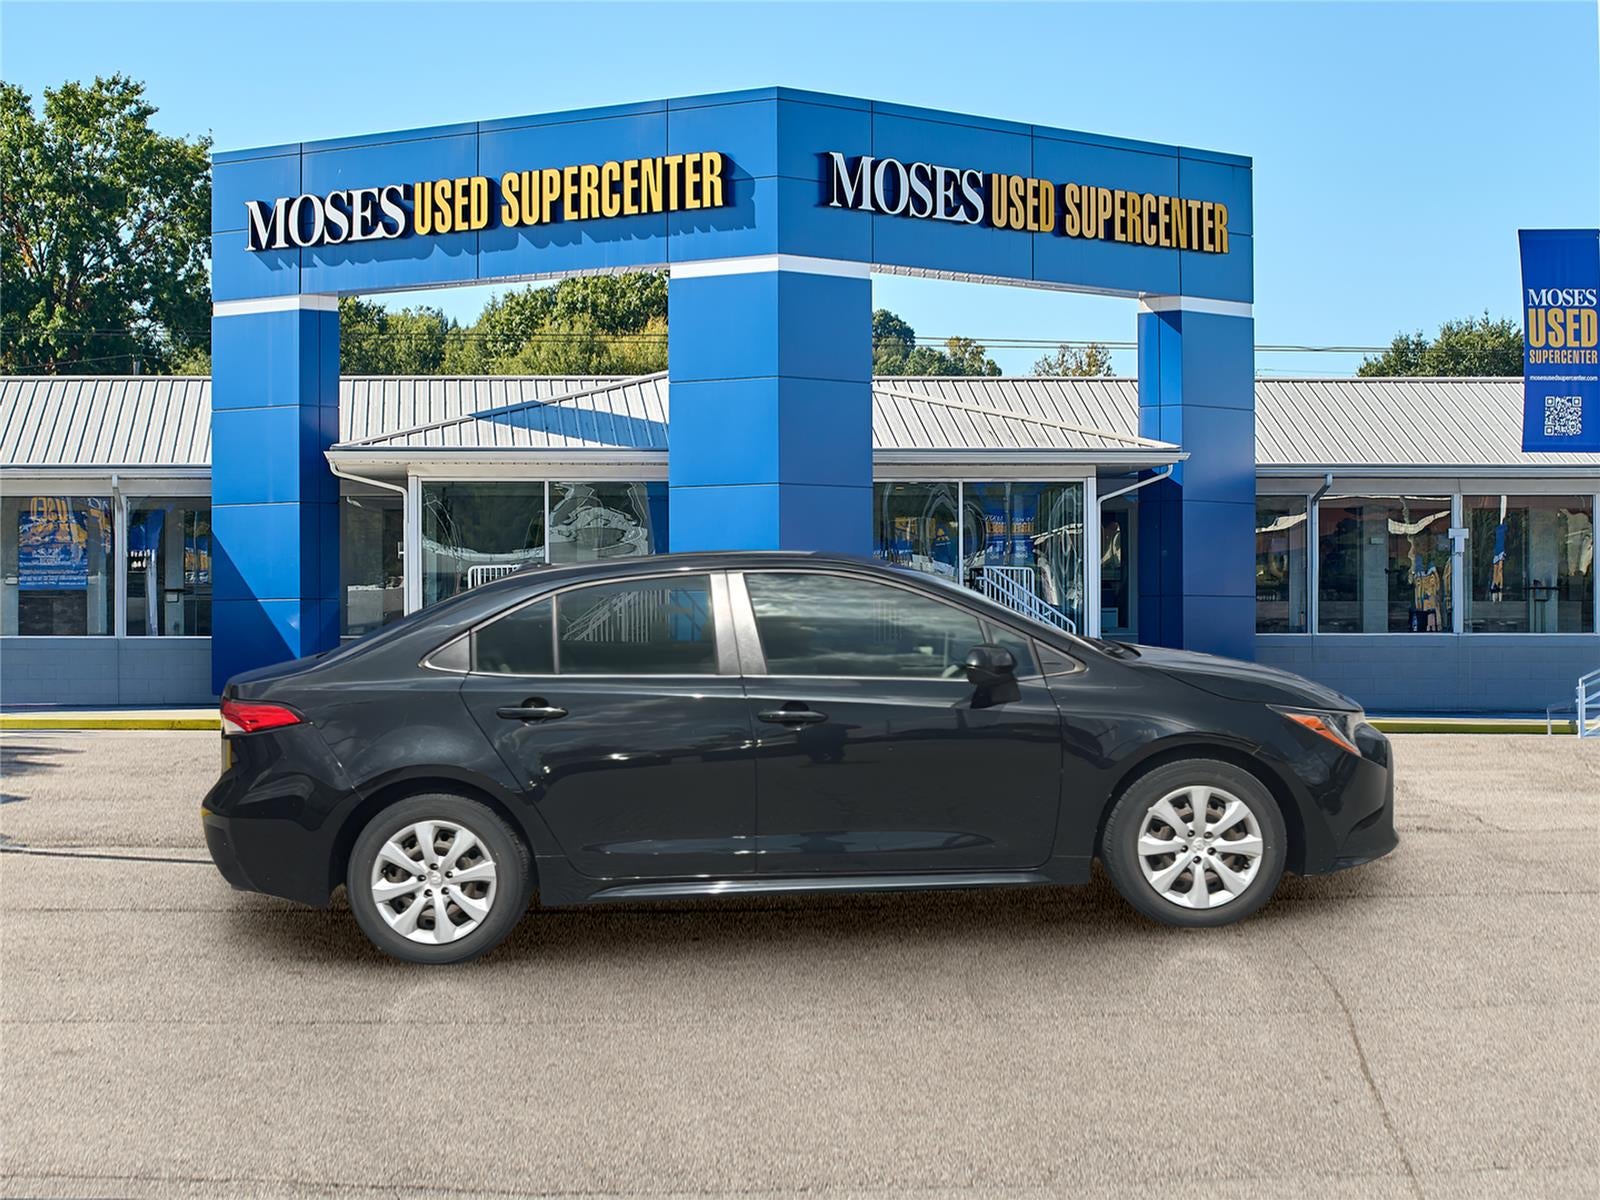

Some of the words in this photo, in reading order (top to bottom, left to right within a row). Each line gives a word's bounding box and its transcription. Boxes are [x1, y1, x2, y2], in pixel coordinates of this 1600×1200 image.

[244, 184, 406, 251] MOSES
[413, 176, 489, 235] USED
[501, 151, 723, 227] SUPERCENTER
[829, 152, 984, 225] MOSES
[991, 173, 1055, 233] USED
[1065, 183, 1229, 253] SUPERCENTER
[1527, 288, 1597, 307] MOSES
[1528, 308, 1598, 348] USED
[1529, 350, 1598, 365] SUPERCENTER
[1529, 374, 1598, 382] mosesusedsupercenter.com
